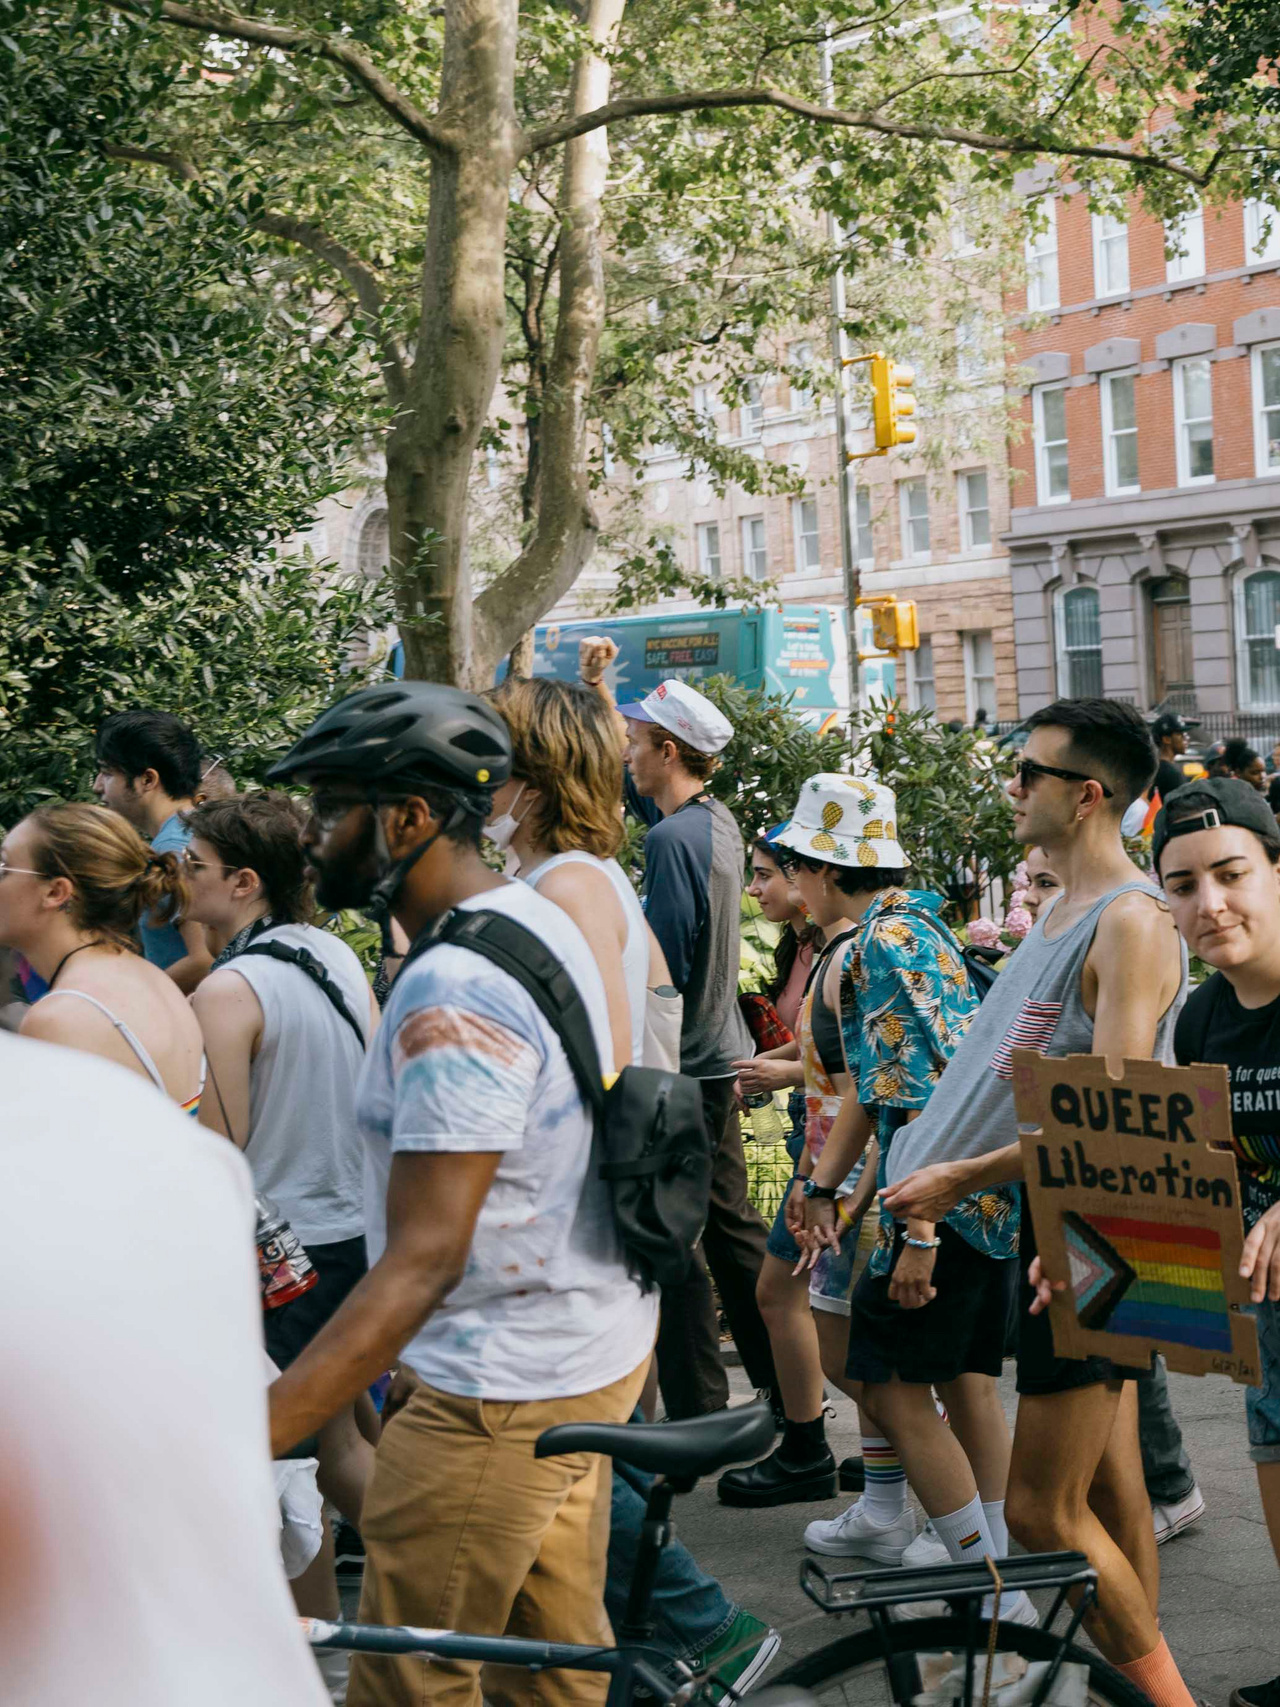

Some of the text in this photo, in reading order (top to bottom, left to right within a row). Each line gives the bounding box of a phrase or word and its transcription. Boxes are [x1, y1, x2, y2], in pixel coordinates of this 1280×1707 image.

[1236, 1066, 1254, 1082] for
[1051, 1083, 1196, 1143] QUEER
[1037, 1141, 1233, 1207] Liberation
